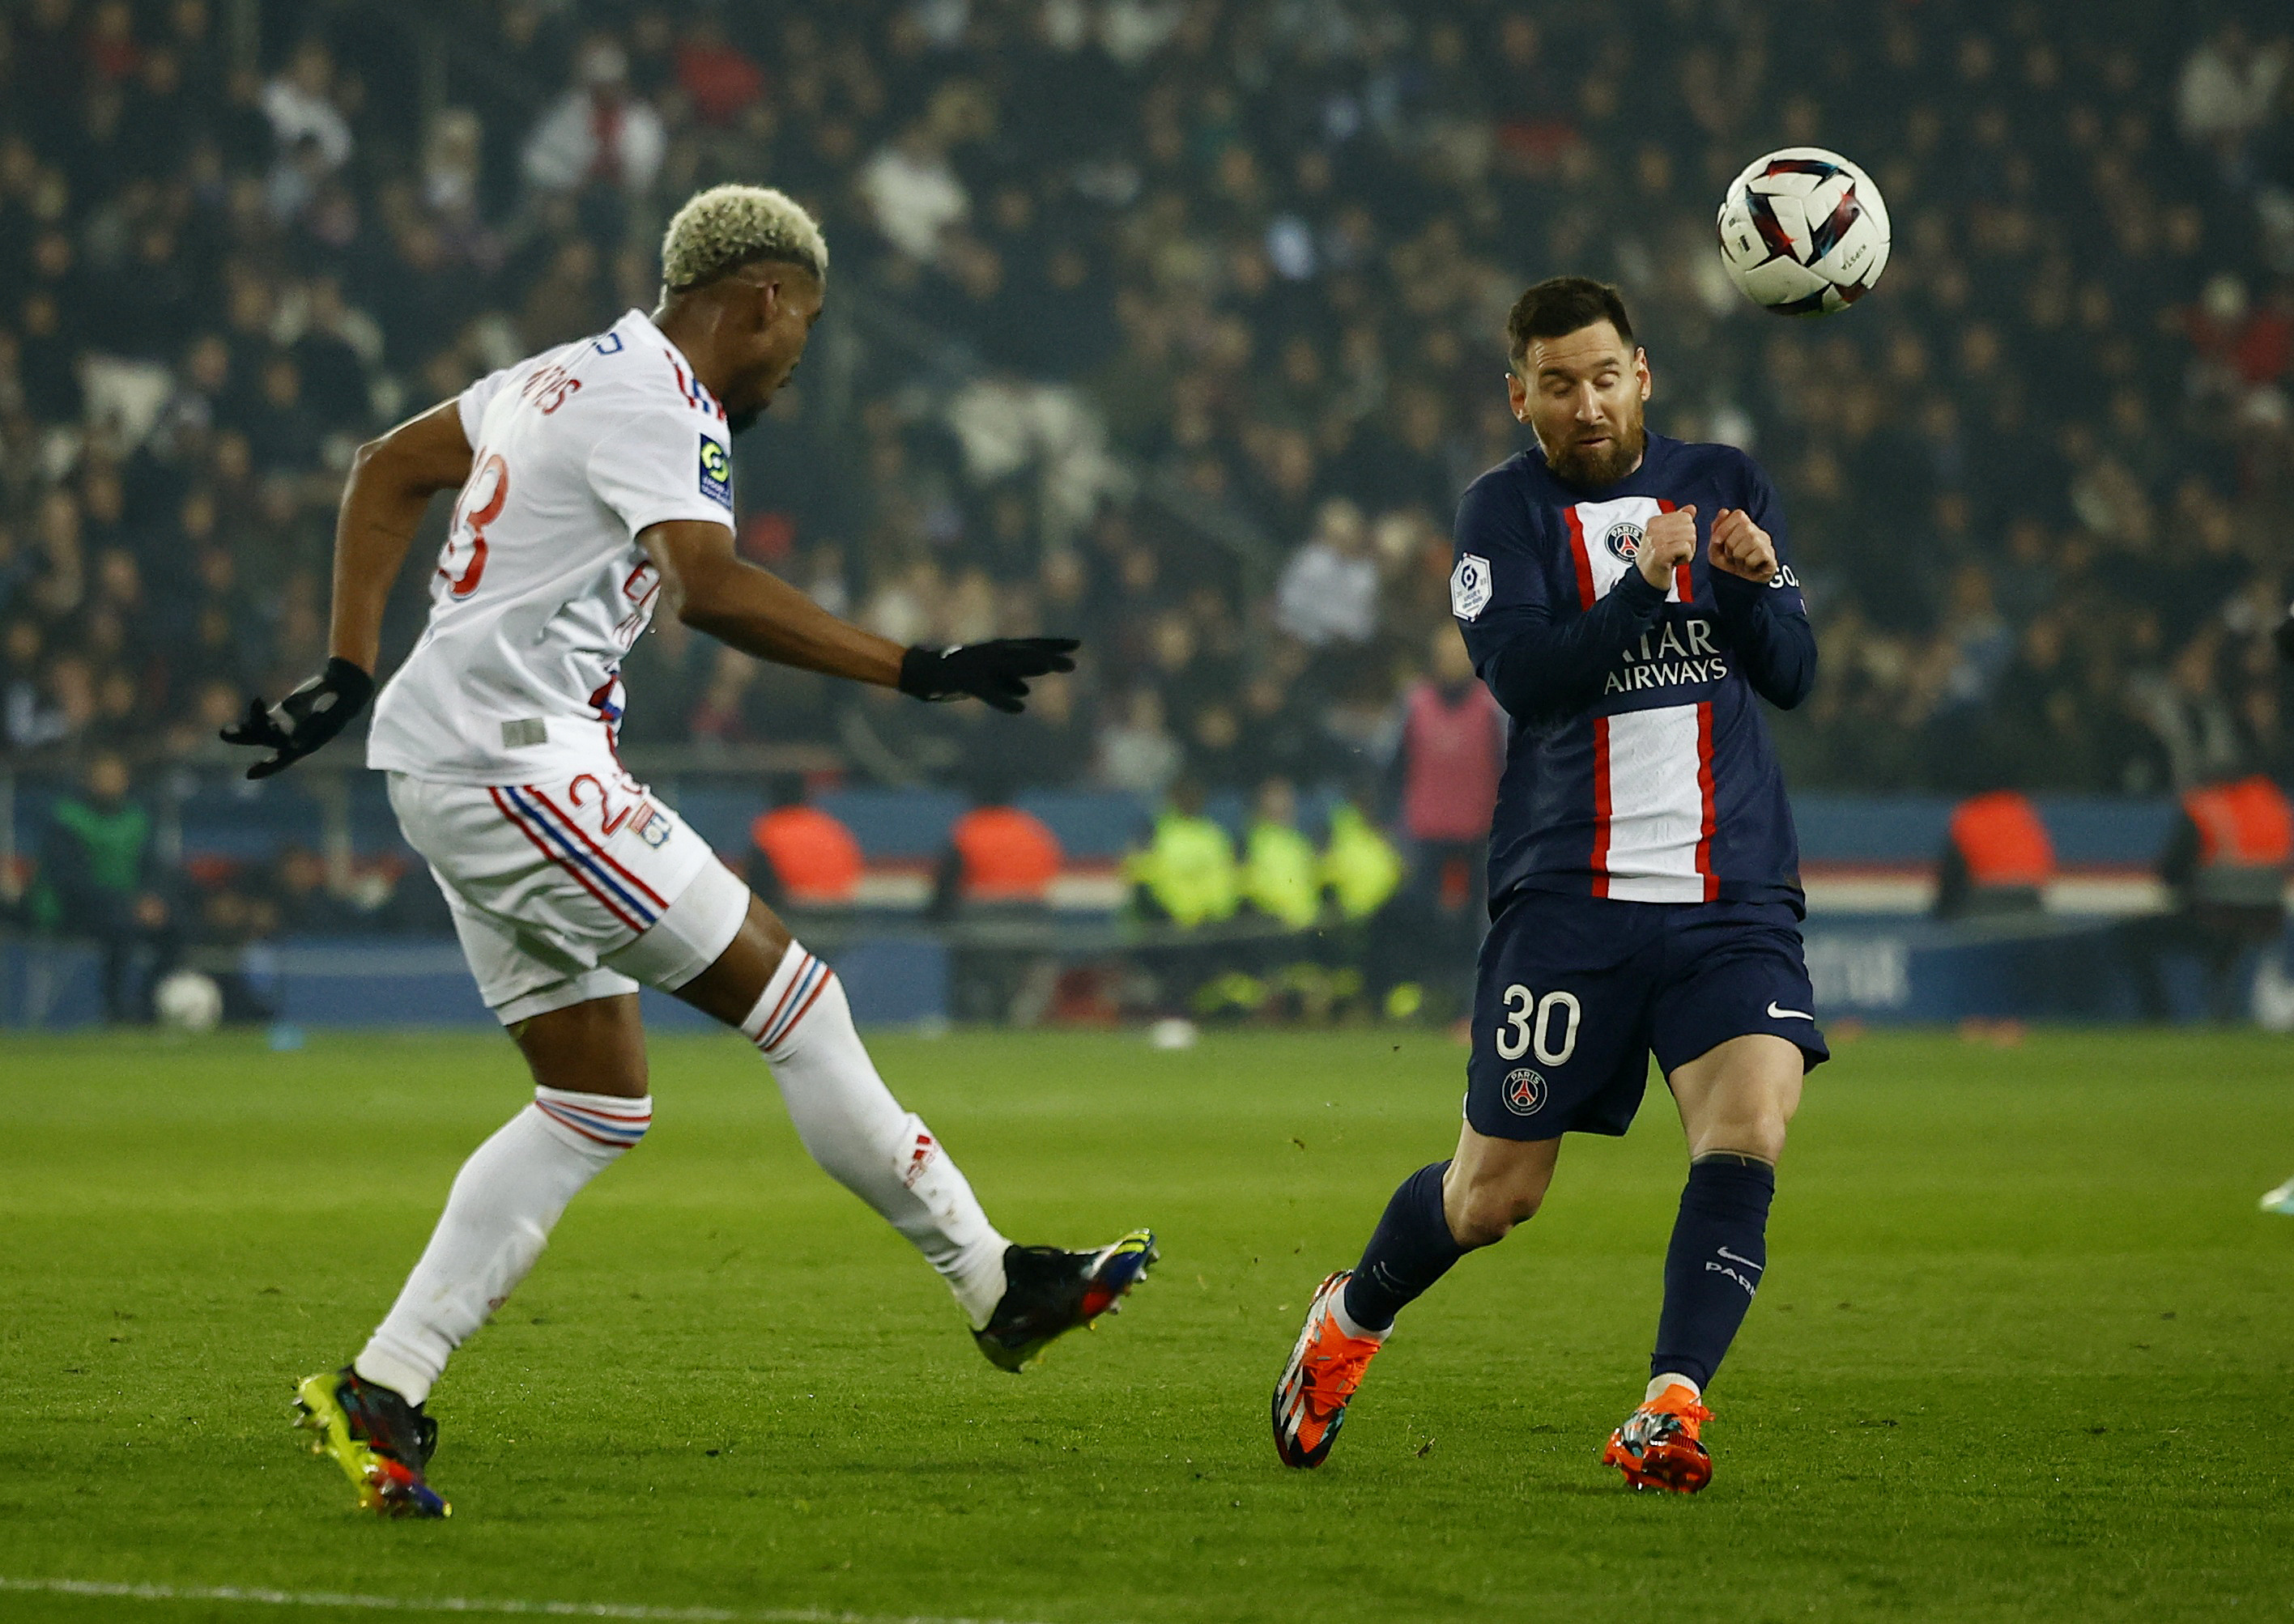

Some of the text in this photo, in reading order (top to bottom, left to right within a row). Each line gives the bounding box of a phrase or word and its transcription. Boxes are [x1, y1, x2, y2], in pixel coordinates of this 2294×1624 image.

[1611, 526, 1640, 537] PARIS
[1604, 657, 1727, 695] AIRWAYS
[1496, 984, 1581, 1066] 30
[1511, 1071, 1541, 1085] PARIS
[1705, 1261, 1756, 1296] PARI
